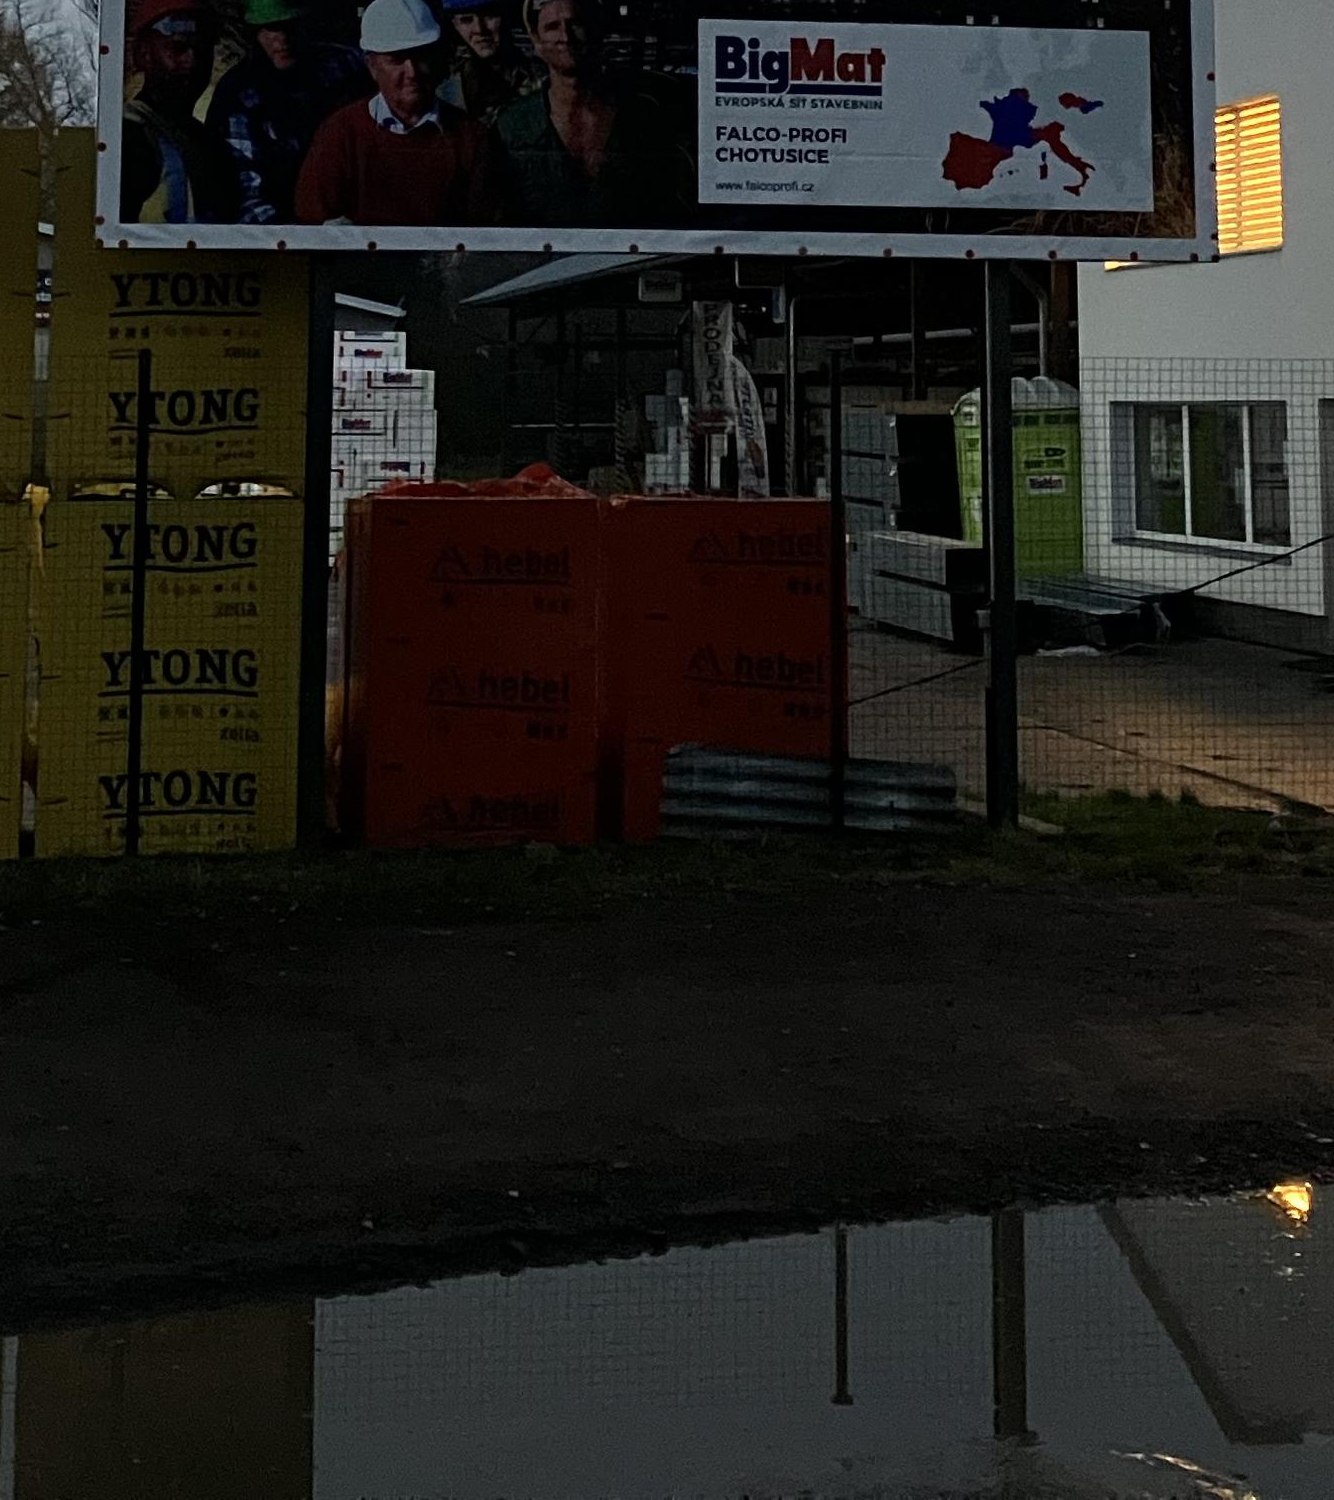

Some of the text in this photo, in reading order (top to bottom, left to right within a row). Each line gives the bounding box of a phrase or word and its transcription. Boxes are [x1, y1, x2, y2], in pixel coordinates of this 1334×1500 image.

[715, 36, 886, 95] BigMat
[715, 125, 848, 145] FALCO-PROFI
[715, 147, 830, 164] CHOTUSICE
[109, 272, 261, 308] YTONG
[108, 387, 260, 426] YTONG
[101, 522, 258, 563] YTONG
[102, 649, 258, 688] YTONG
[98, 770, 258, 810] YTONG
